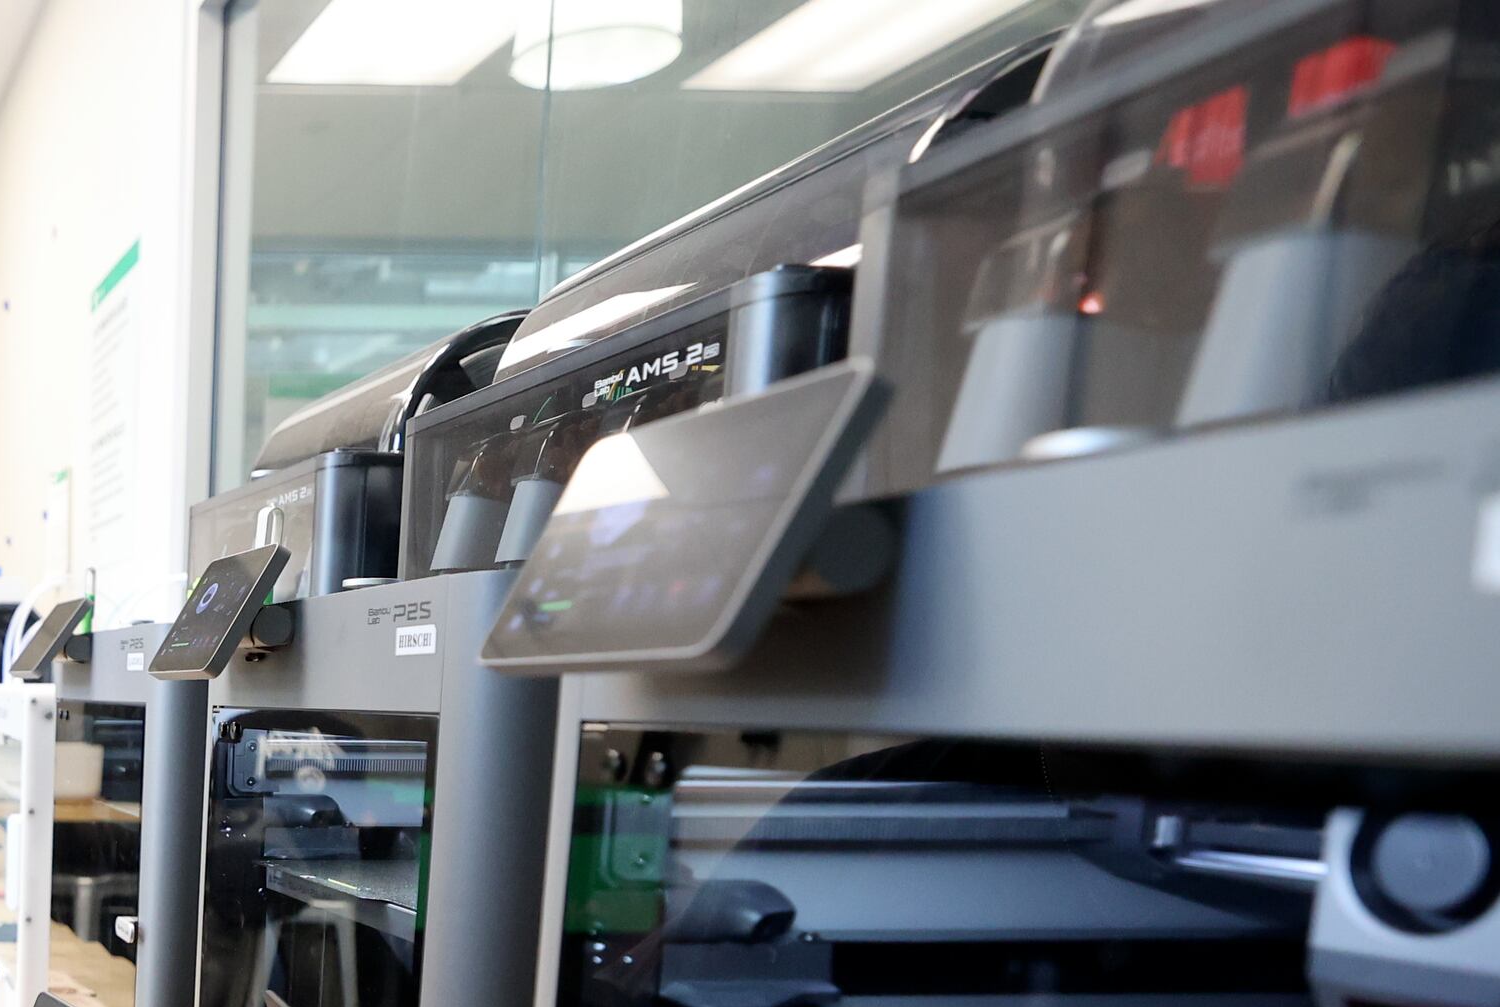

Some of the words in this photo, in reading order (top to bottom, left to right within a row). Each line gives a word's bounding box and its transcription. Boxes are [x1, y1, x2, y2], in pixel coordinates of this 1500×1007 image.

[625, 351, 679, 386] AMS
[685, 342, 703, 365] 2
[594, 371, 624, 390] Bambu
[594, 385, 611, 397] Lab
[278, 489, 299, 506] AMS
[367, 607, 391, 617] Bambu
[367, 617, 380, 625] Lab
[398, 633, 432, 649] HIRSCHI
